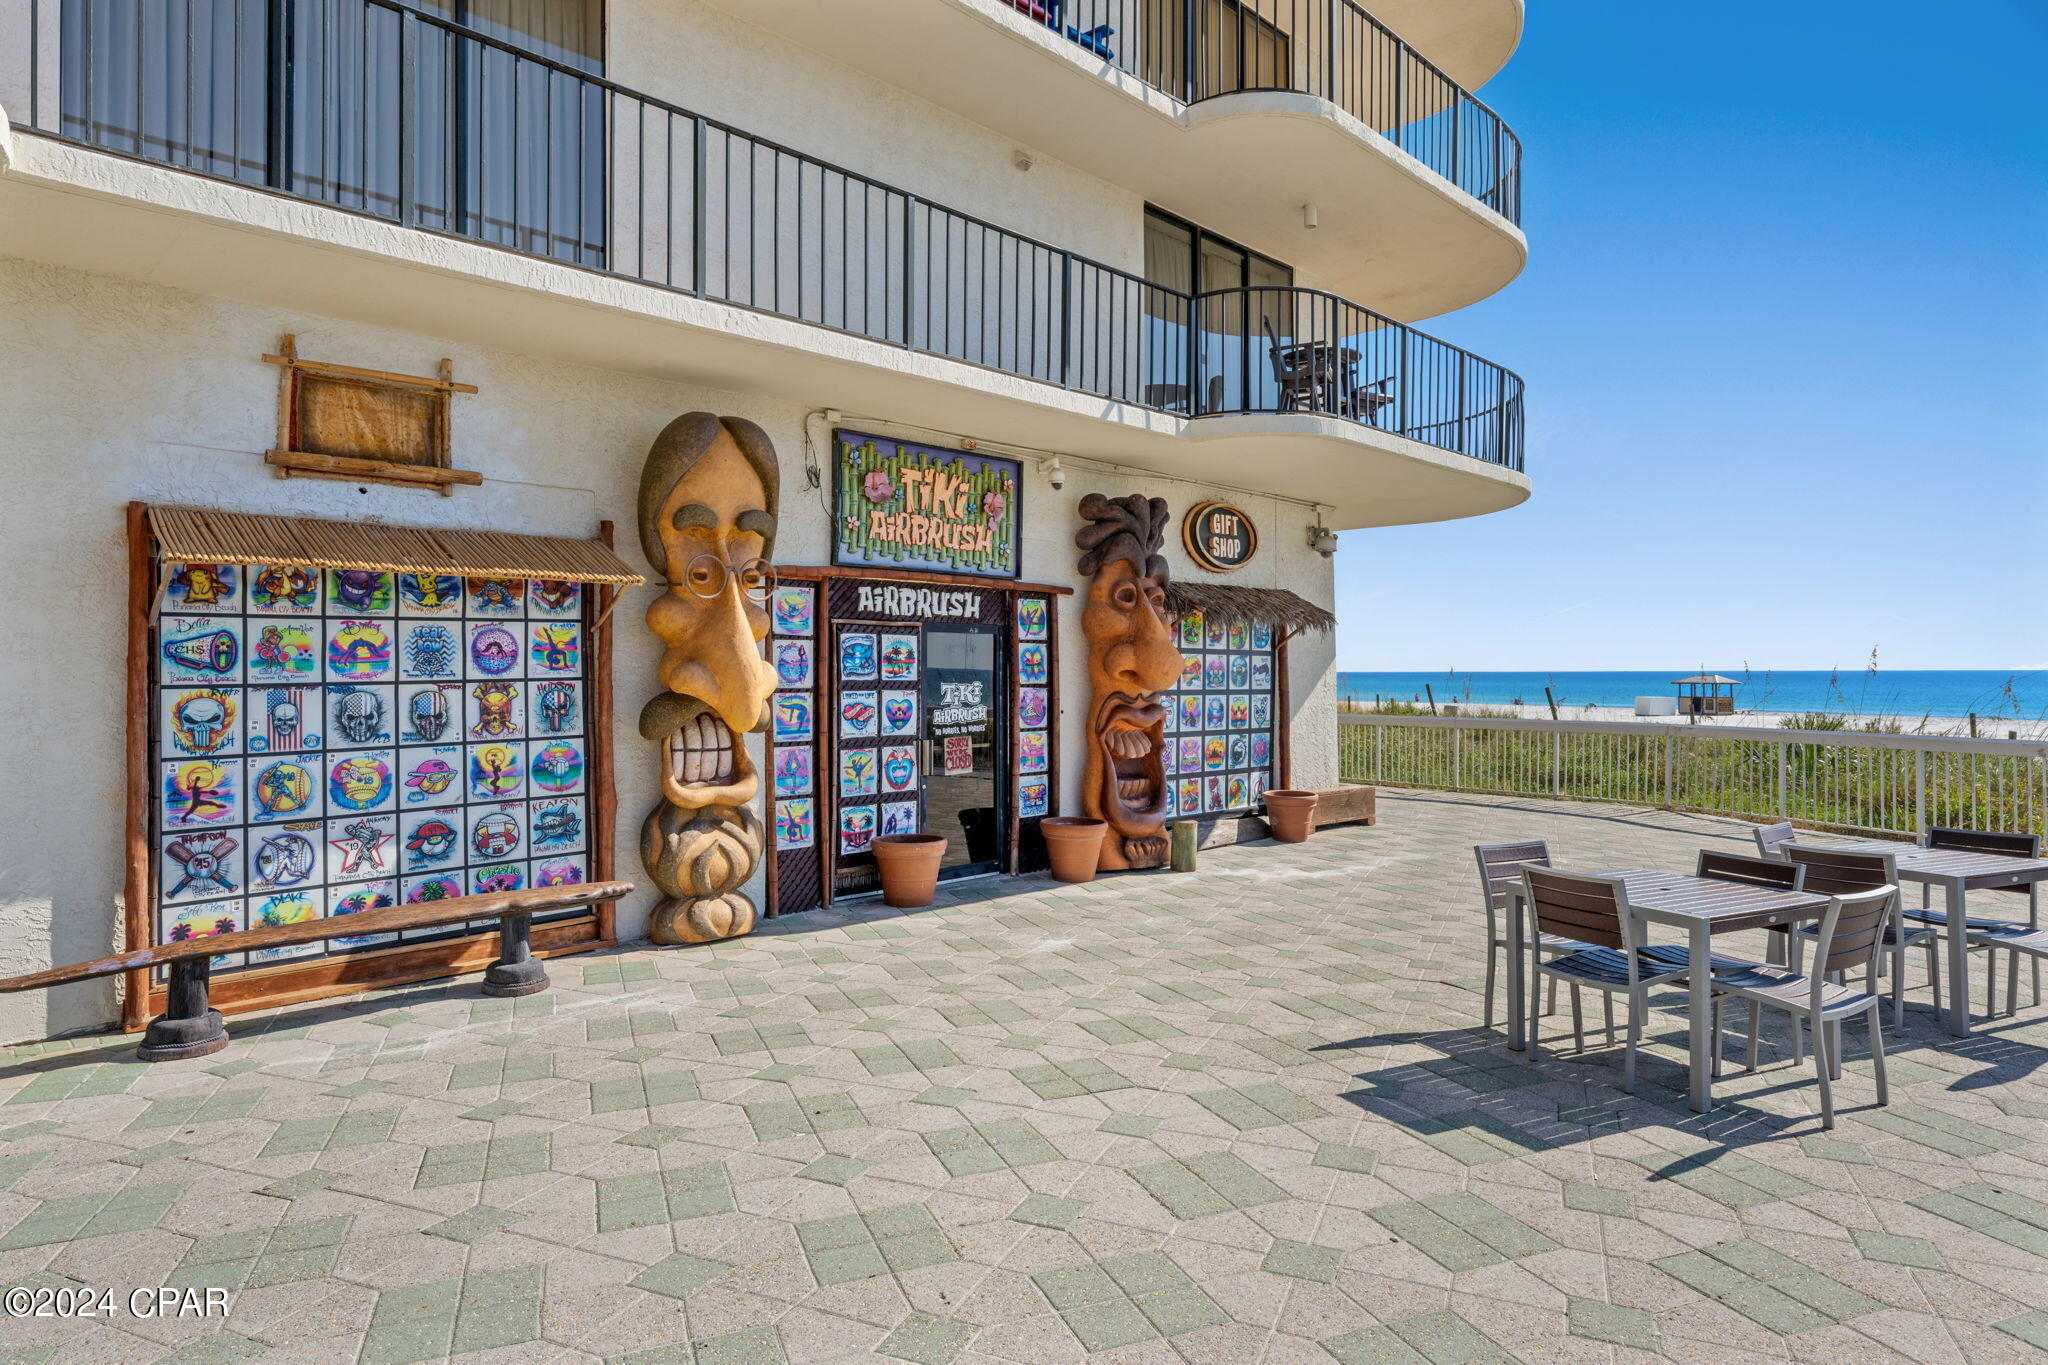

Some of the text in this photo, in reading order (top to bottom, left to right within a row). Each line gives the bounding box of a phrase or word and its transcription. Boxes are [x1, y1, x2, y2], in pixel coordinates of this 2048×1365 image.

[1211, 513, 1239, 536] GIFT
[1211, 536, 1241, 559] SHOP
[175, 645, 205, 654] CHS
[537, 682, 576, 695] HUDSON
[946, 737, 969, 749] SORRY
[532, 798, 578, 815] KEATON
[283, 821, 324, 832] SHANE
[174, 830, 228, 846] THOMPSON
[266, 891, 310, 908] BLAKE
